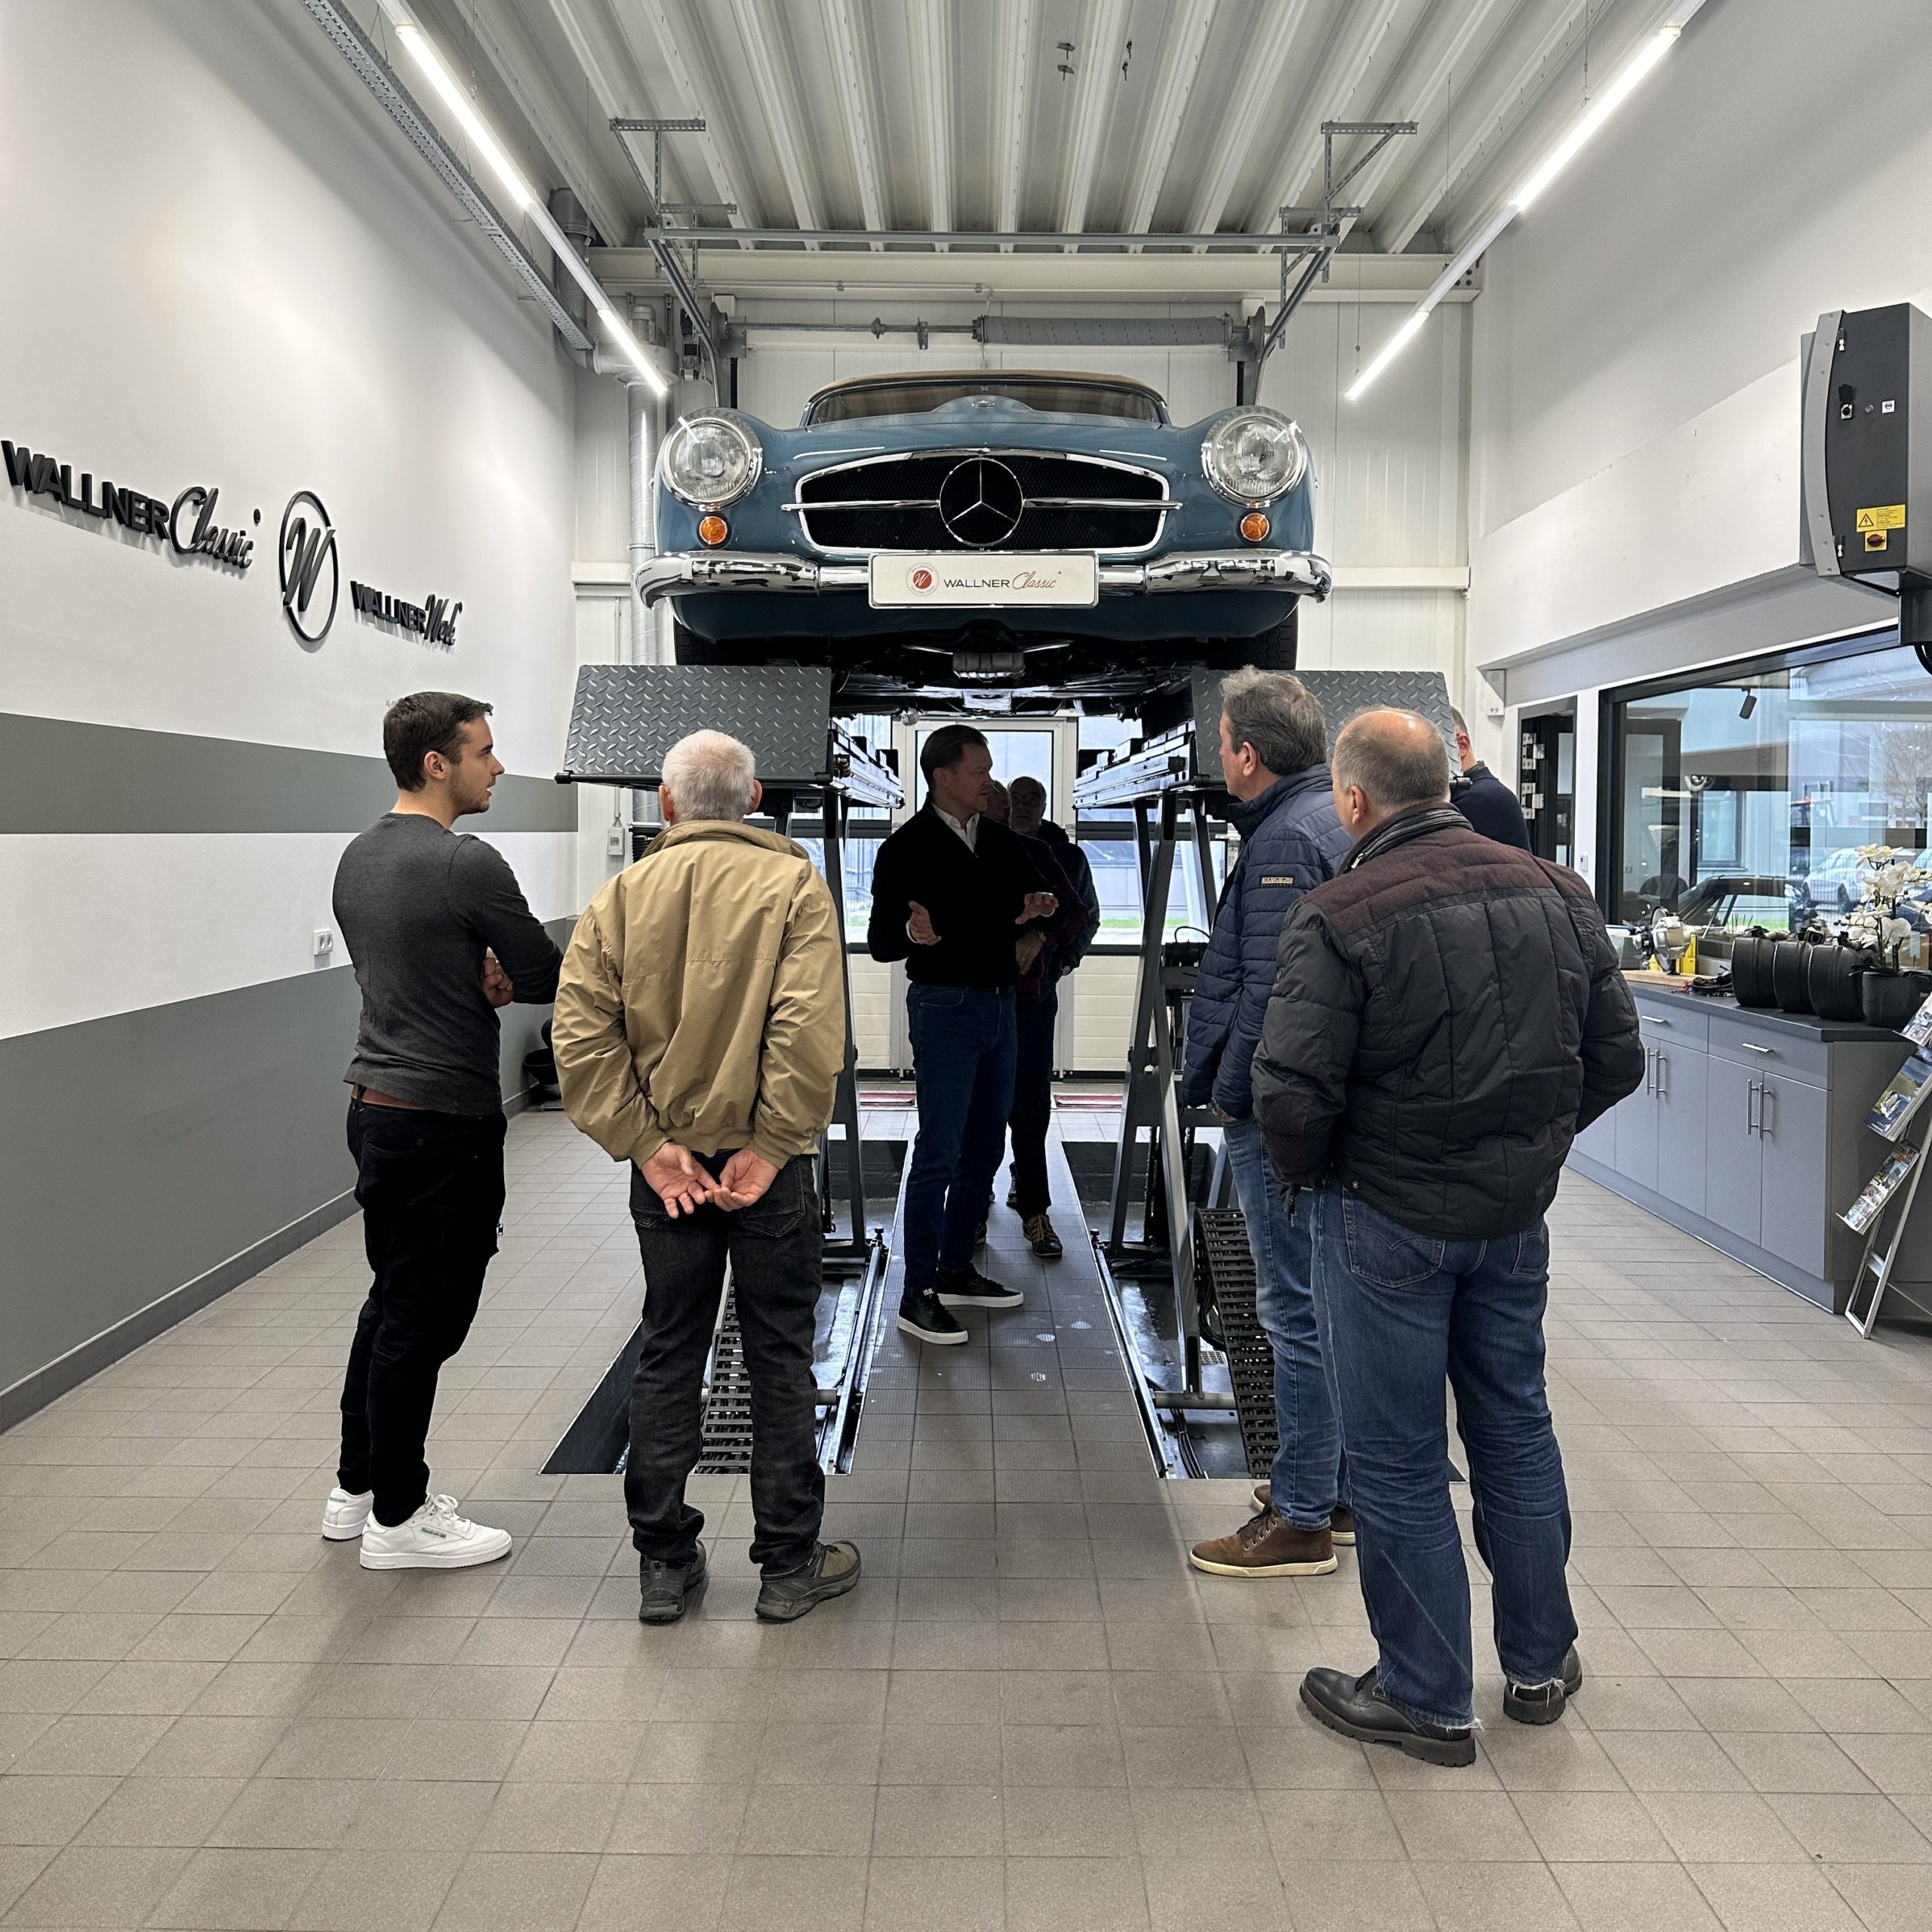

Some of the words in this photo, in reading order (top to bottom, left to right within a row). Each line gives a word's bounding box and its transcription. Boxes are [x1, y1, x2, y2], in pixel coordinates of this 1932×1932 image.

[1, 439, 170, 540] WALLNER
[170, 486, 254, 569] Classic
[350, 580, 427, 634] WALLNER
[943, 579, 1011, 588] WALLNER
[1011, 571, 1057, 590] Classic
